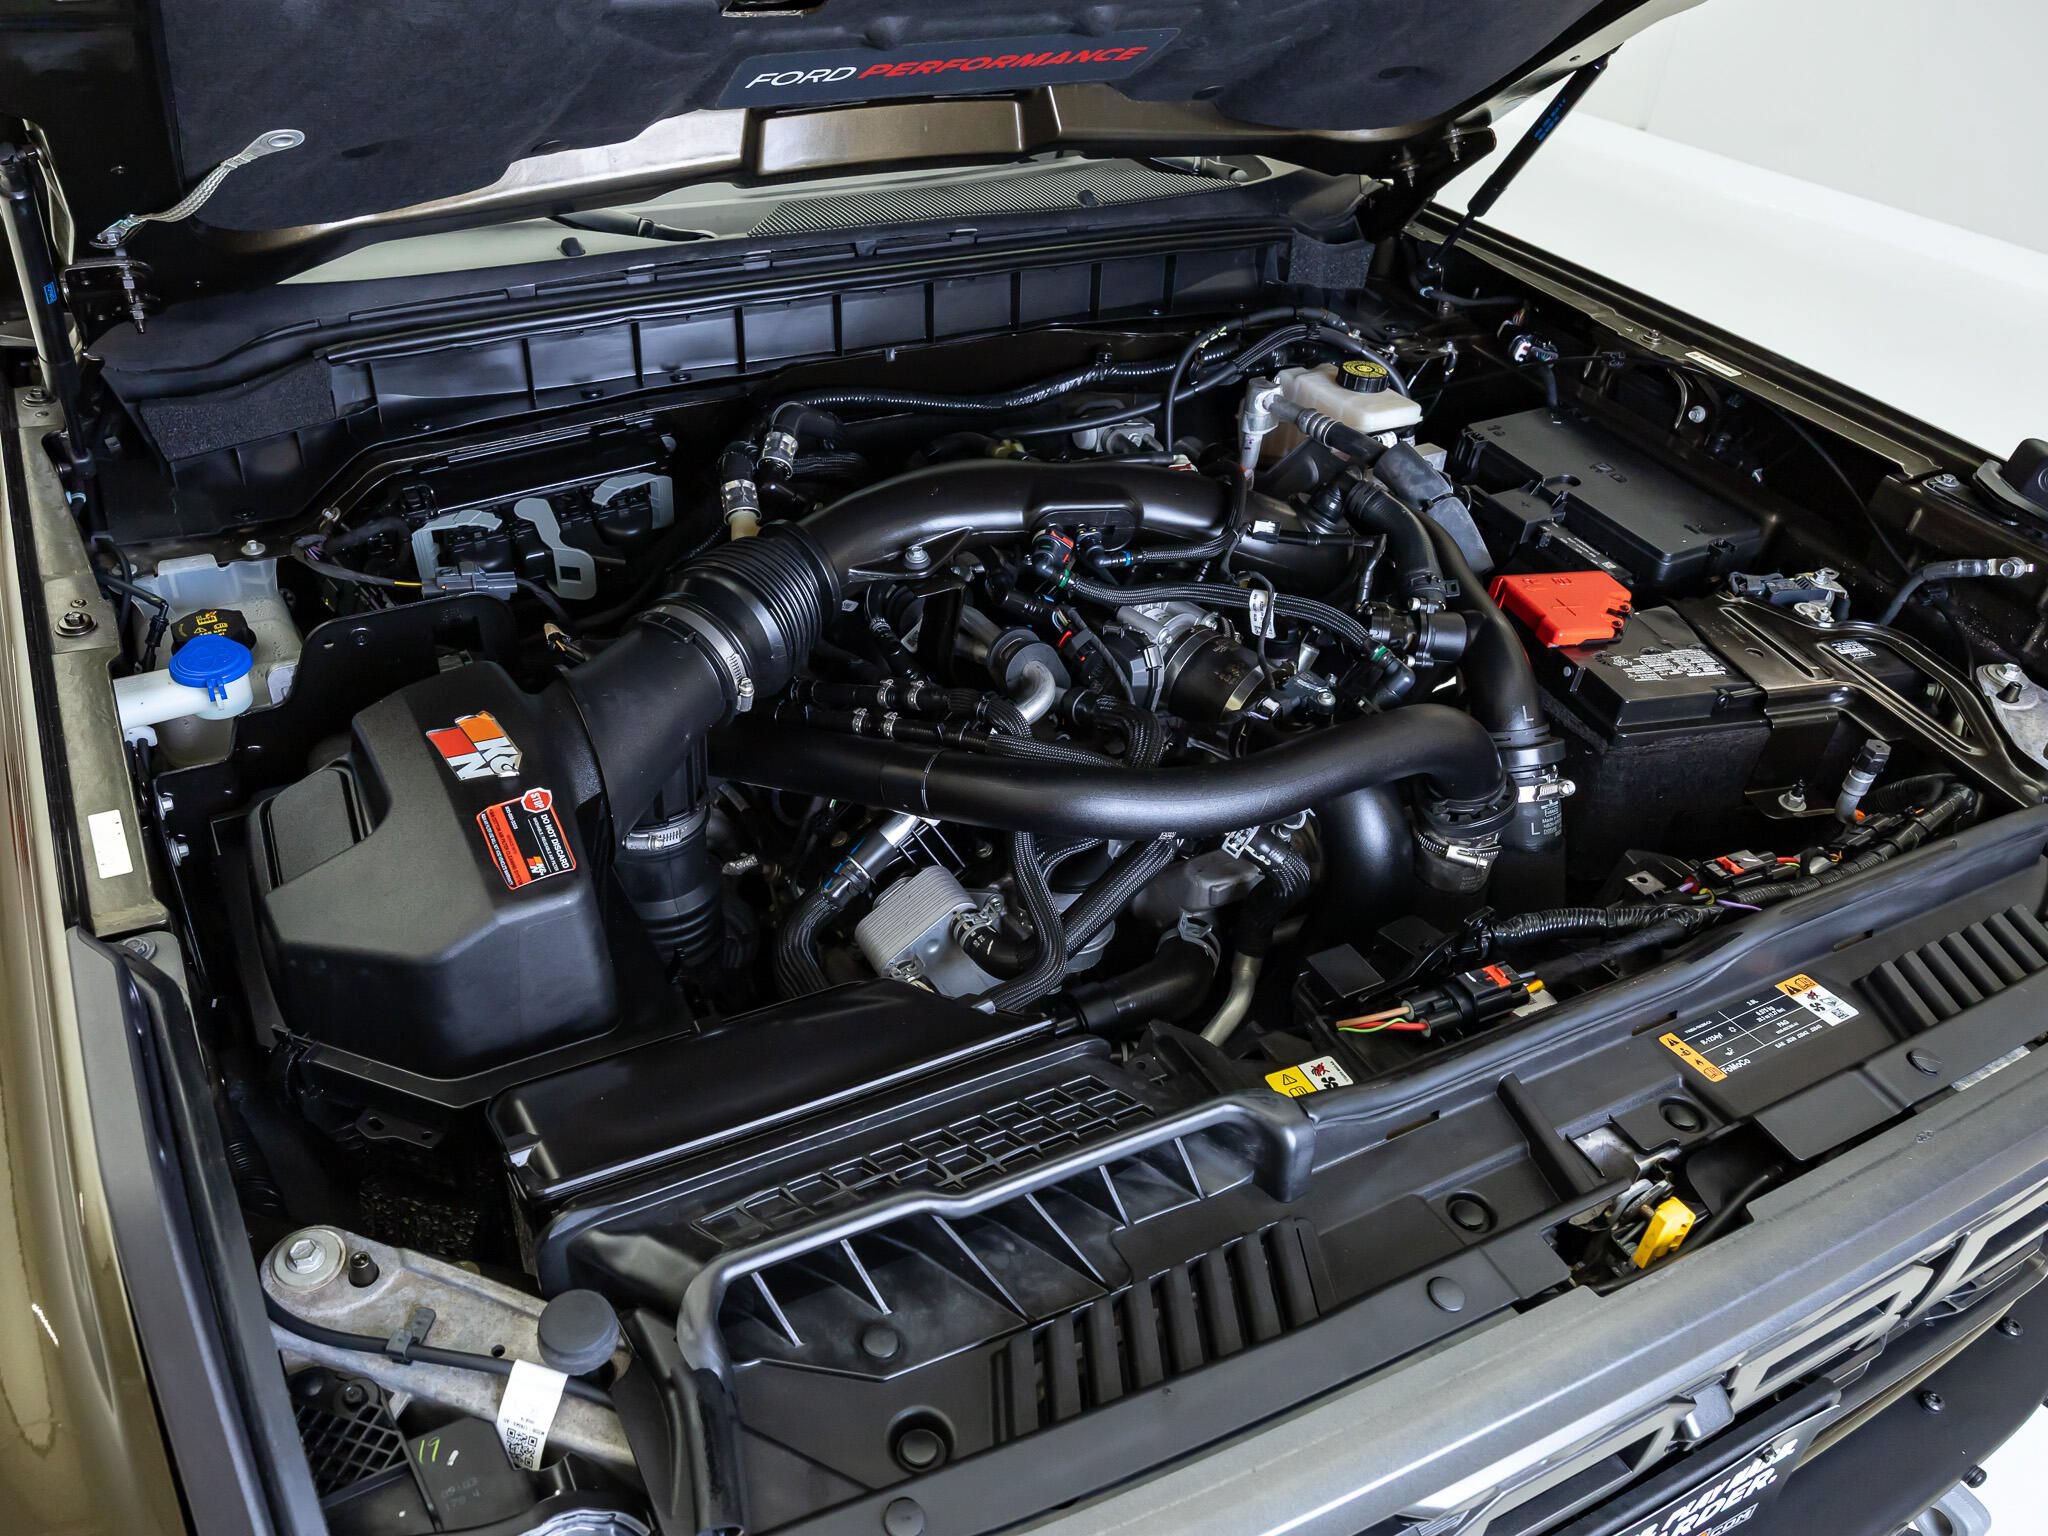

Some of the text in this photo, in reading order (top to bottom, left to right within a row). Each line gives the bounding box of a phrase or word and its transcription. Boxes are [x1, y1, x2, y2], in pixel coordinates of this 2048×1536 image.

[745, 46, 1148, 89] FORD PERFORMANCE
[530, 792, 544, 809] STOP
[540, 813, 569, 868] DO NOT DISCARD
[1531, 822, 1540, 836] L
[1721, 1058, 1751, 1074] FoMoCo
[1661, 1479, 1731, 1531] PLAY
